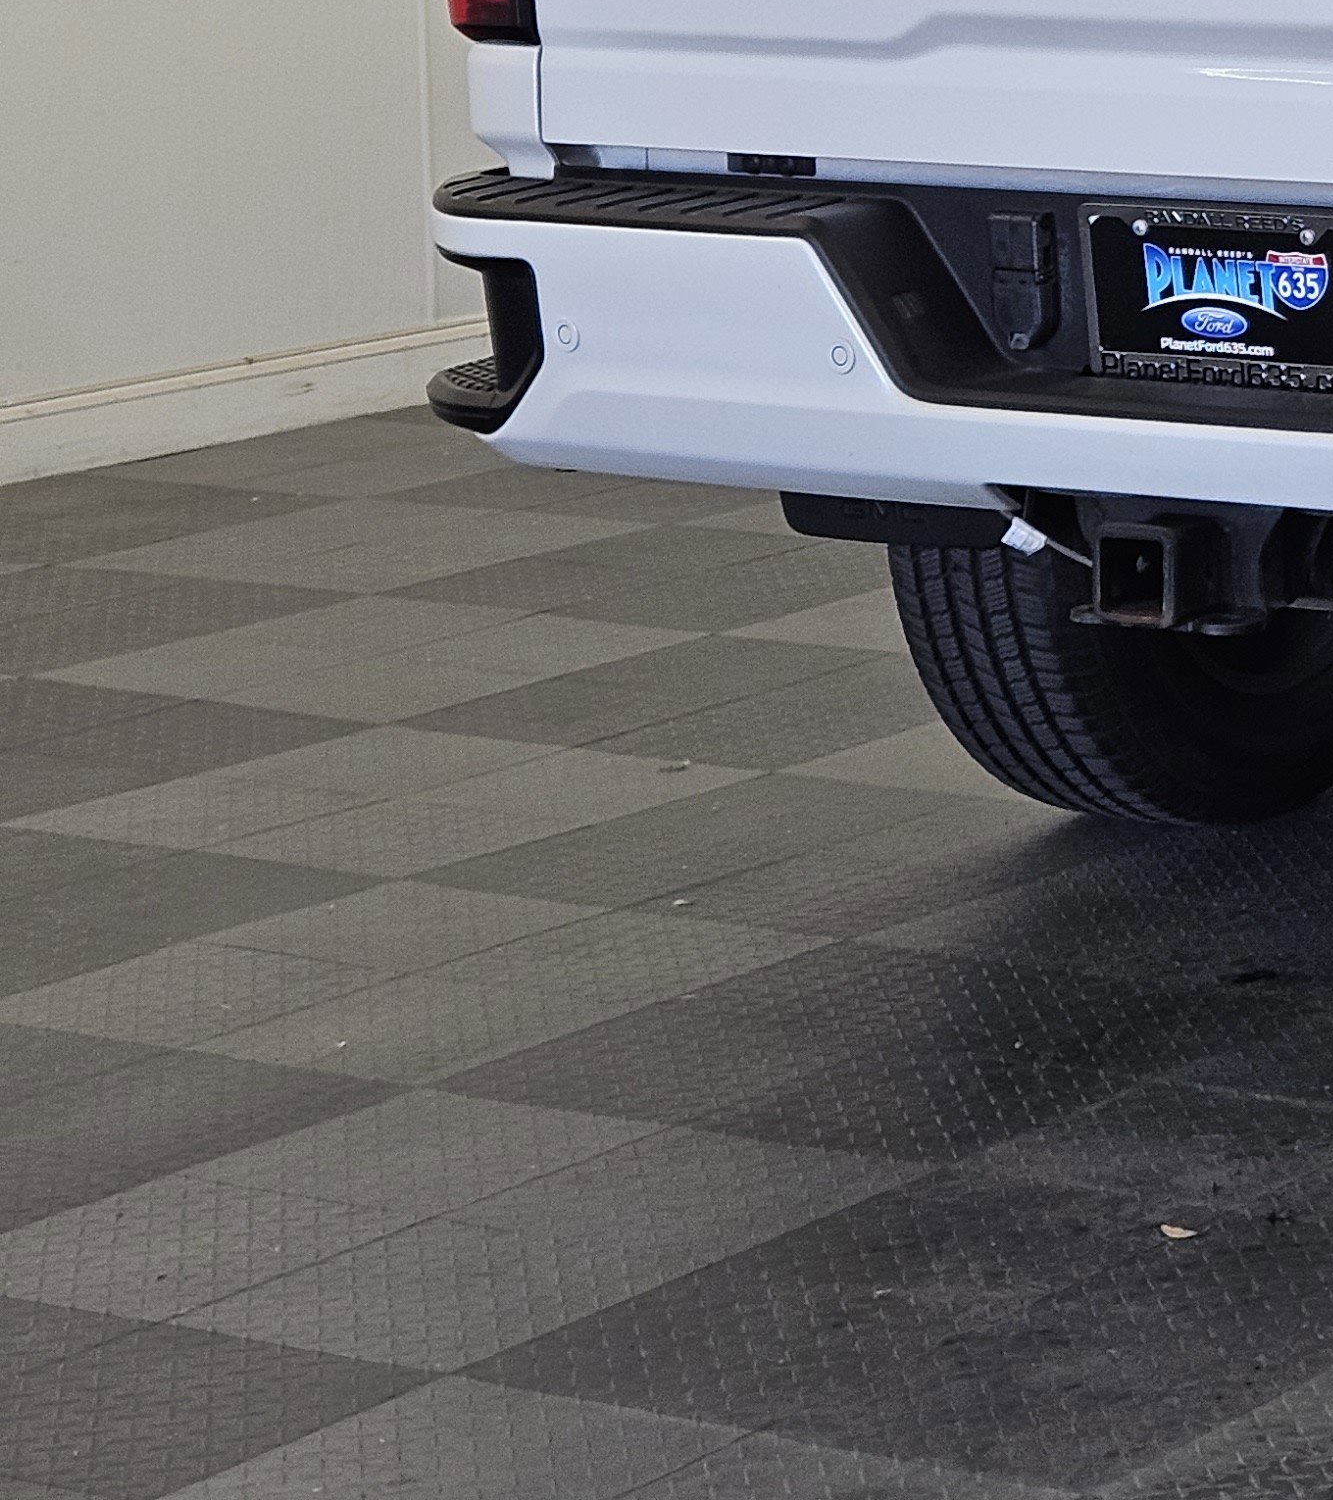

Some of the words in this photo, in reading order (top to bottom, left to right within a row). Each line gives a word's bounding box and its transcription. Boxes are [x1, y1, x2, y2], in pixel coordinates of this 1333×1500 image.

[1145, 209, 1233, 228] RANDALL
[1235, 214, 1305, 232] REED'S
[1143, 243, 1276, 311] PLANET
[1278, 271, 1320, 300] 635
[1194, 312, 1235, 335] Ford
[1160, 336, 1275, 358] PlanetFord635.com
